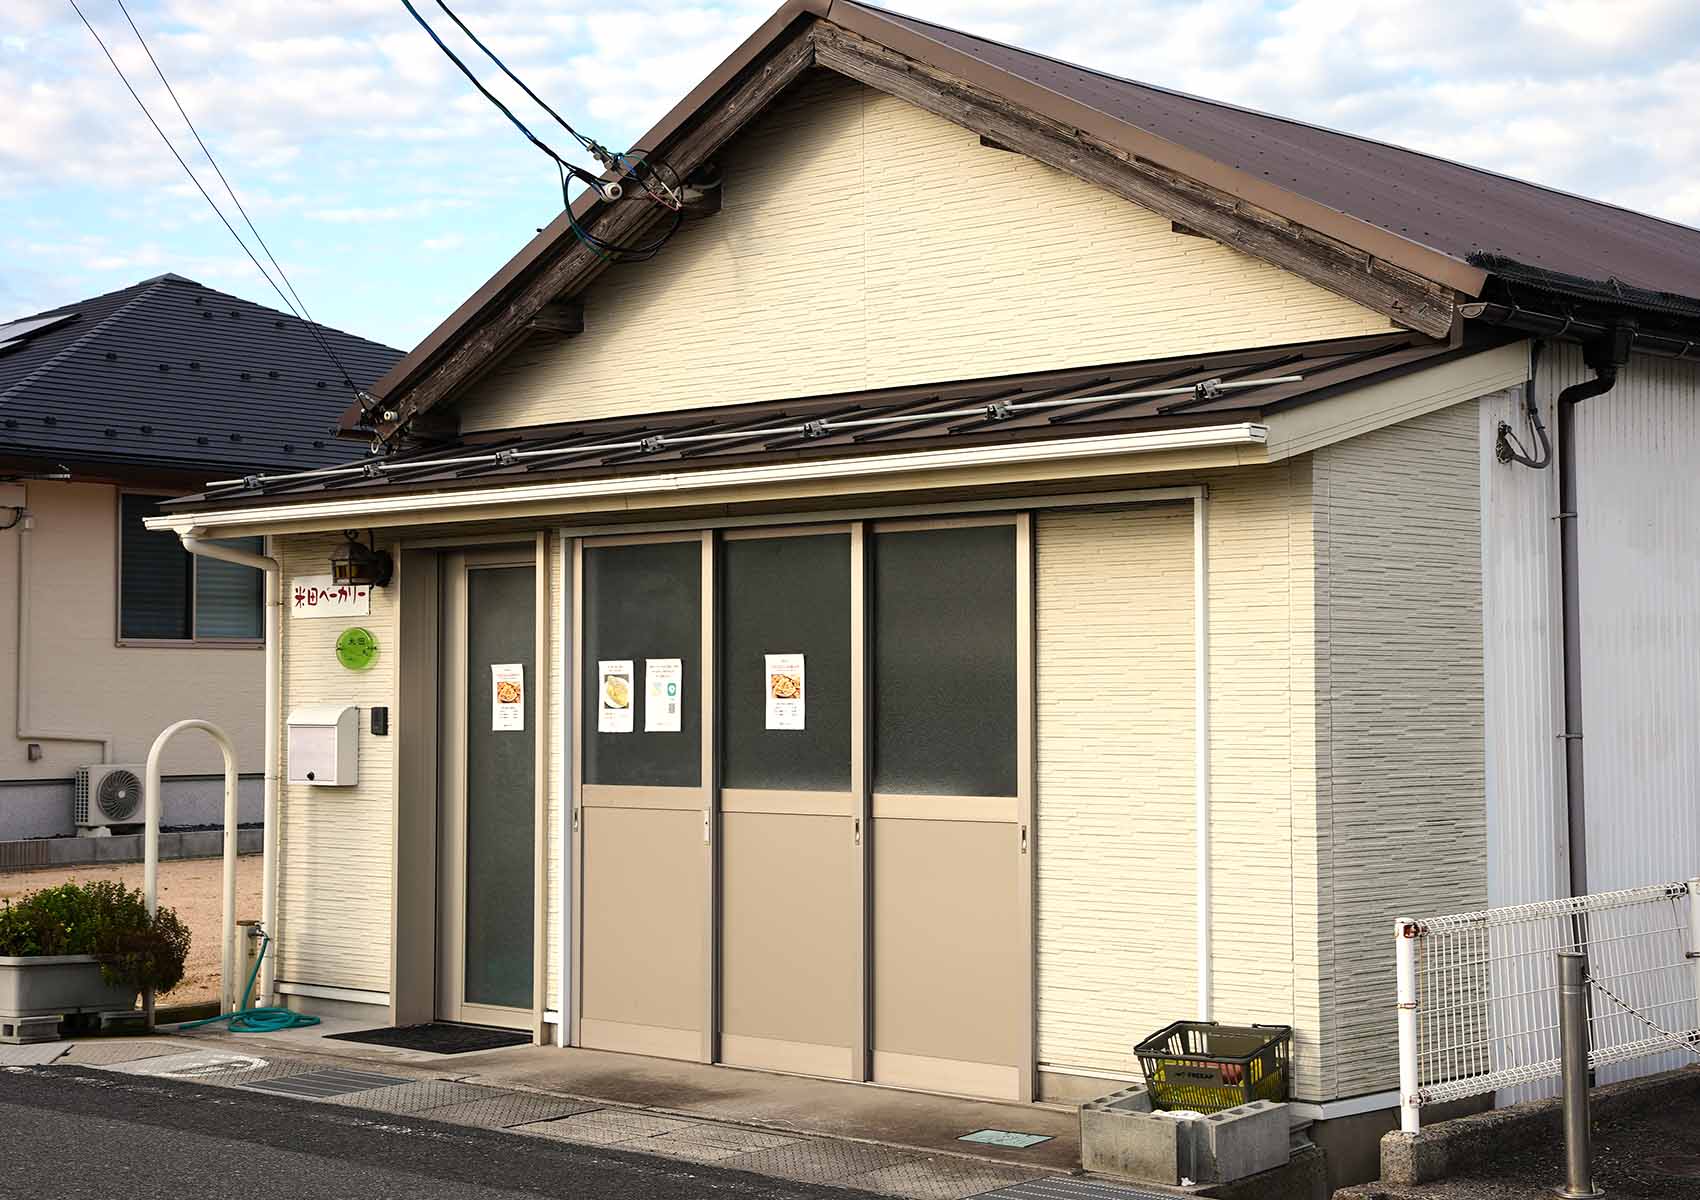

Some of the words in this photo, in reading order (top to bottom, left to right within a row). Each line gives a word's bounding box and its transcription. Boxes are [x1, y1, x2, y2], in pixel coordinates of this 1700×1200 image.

[294, 585, 366, 608] 米田ベーカリー
